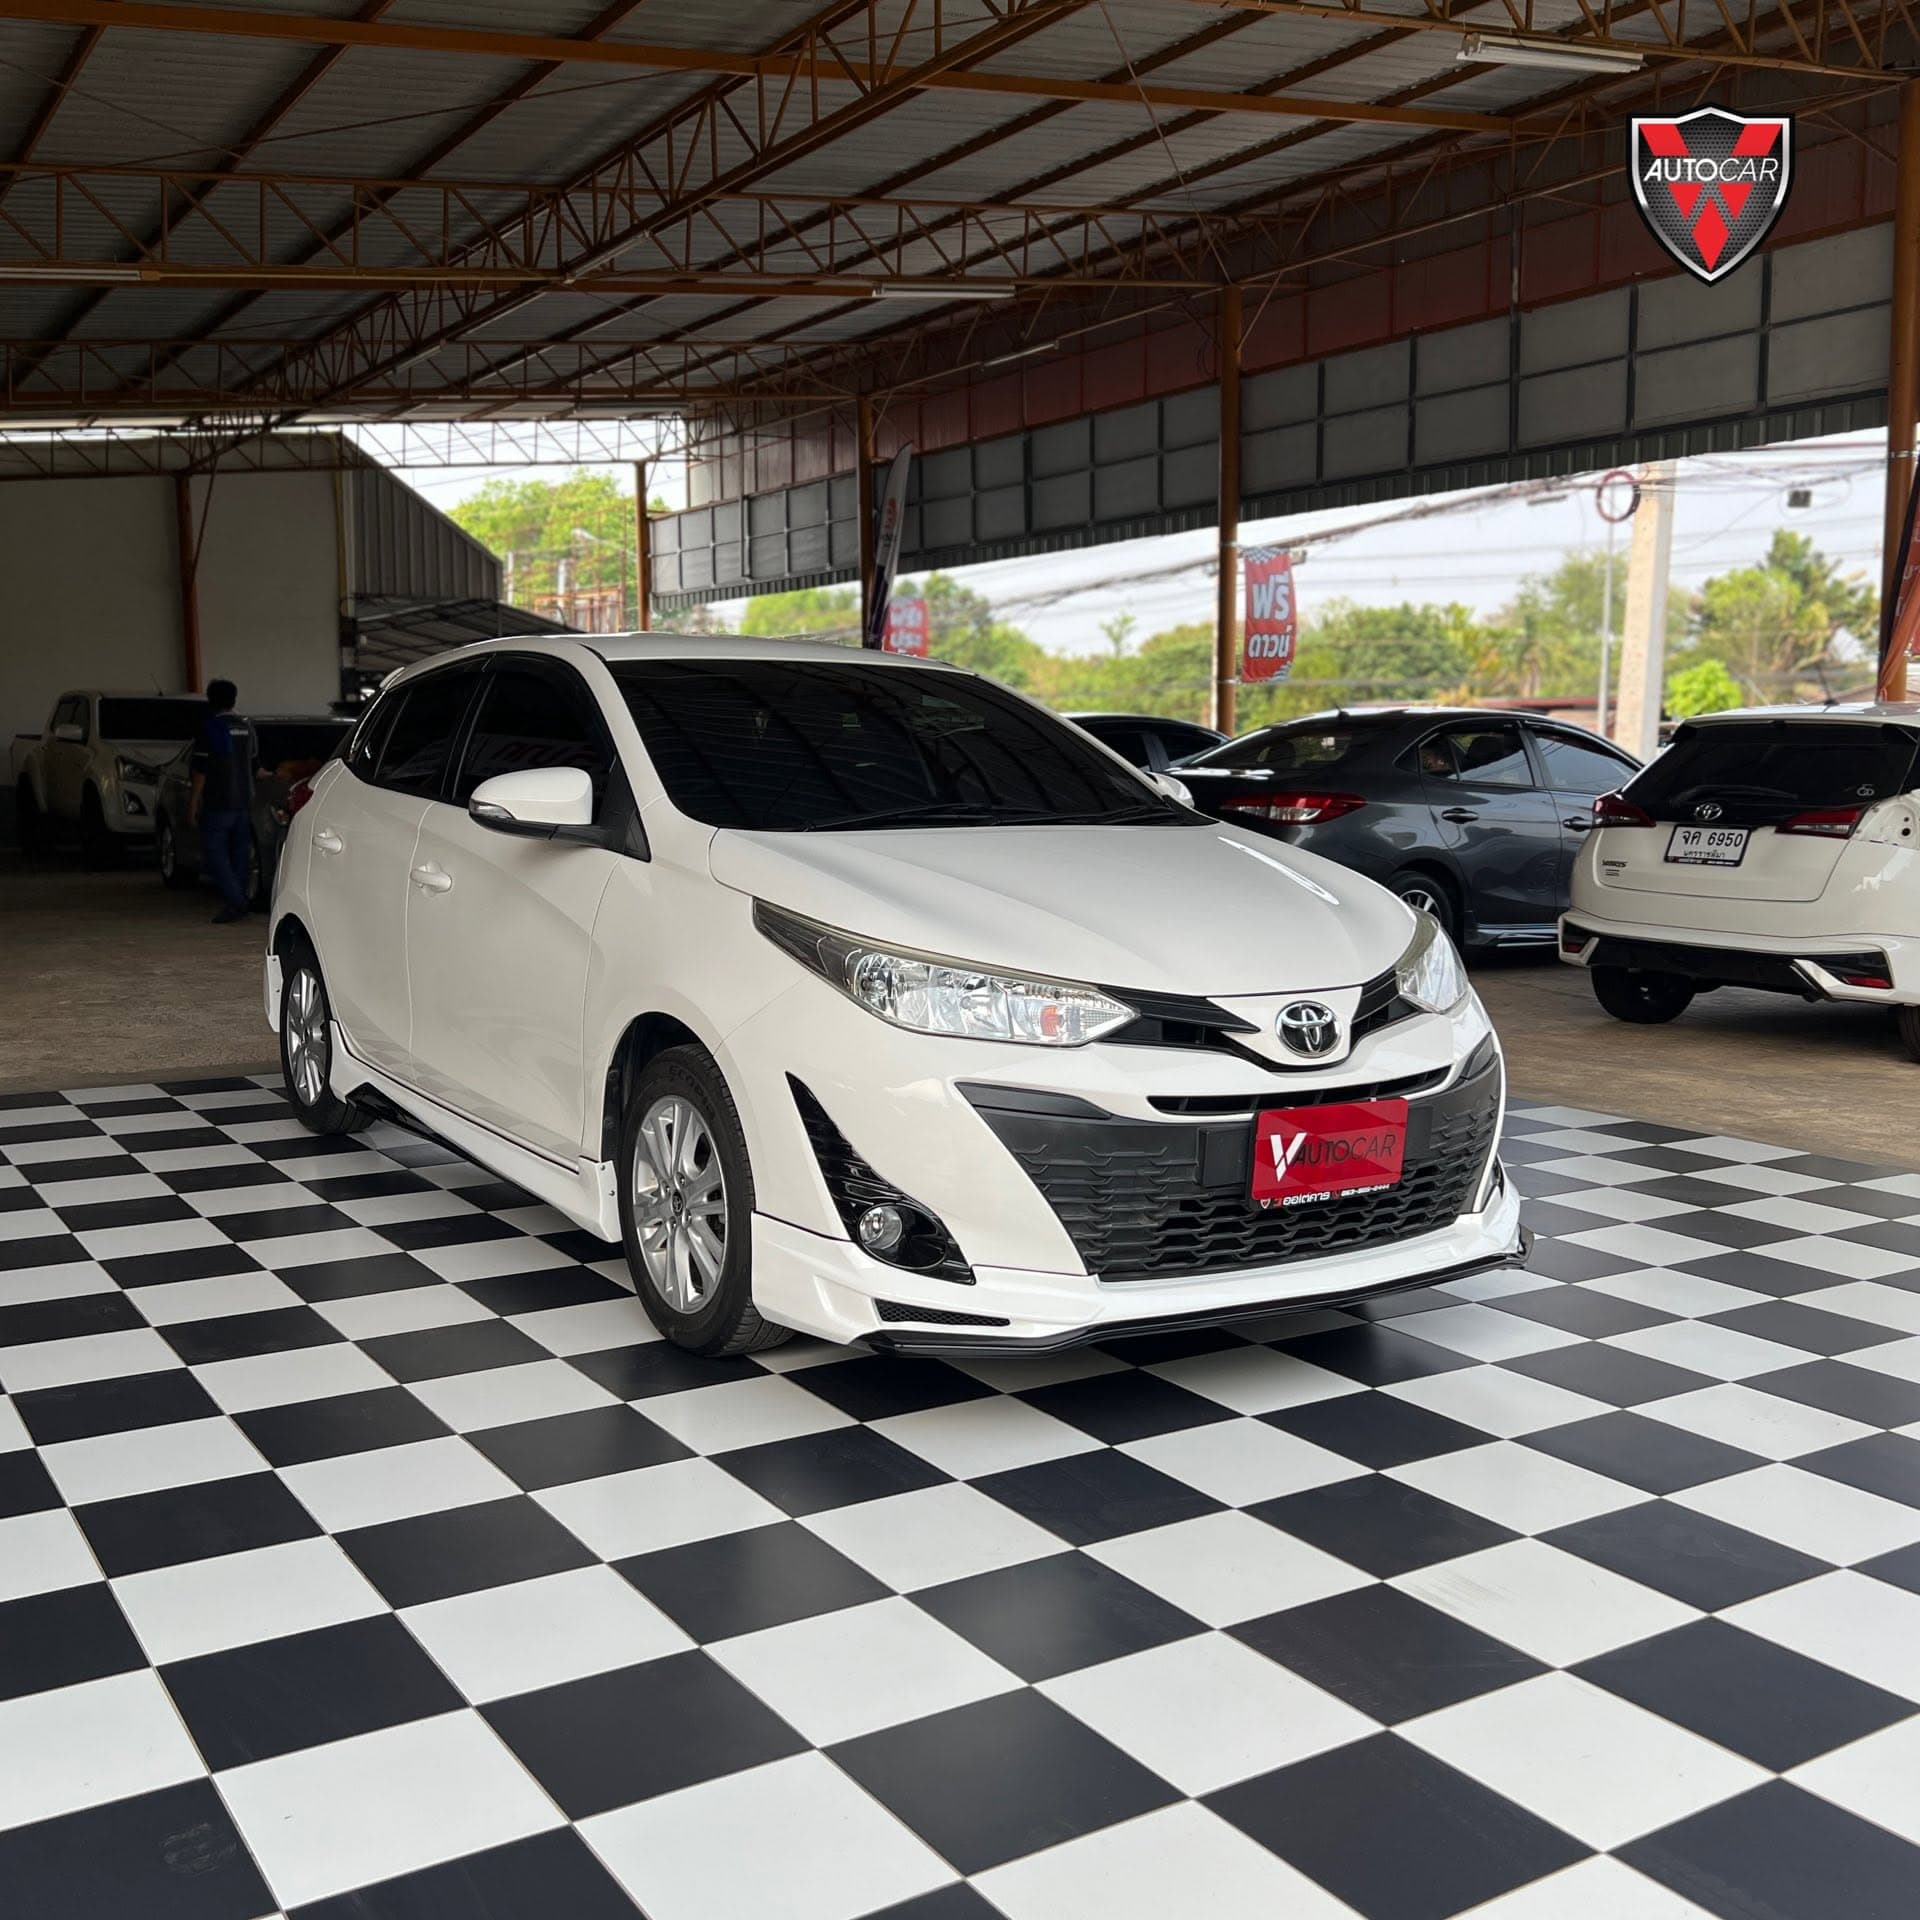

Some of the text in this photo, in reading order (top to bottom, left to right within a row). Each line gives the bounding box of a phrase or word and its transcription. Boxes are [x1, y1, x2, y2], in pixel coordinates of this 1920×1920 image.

[1252, 570, 1291, 621] ฟรี
[1247, 625, 1293, 659] ดาวน์
[1707, 831, 1744, 848] 6950
